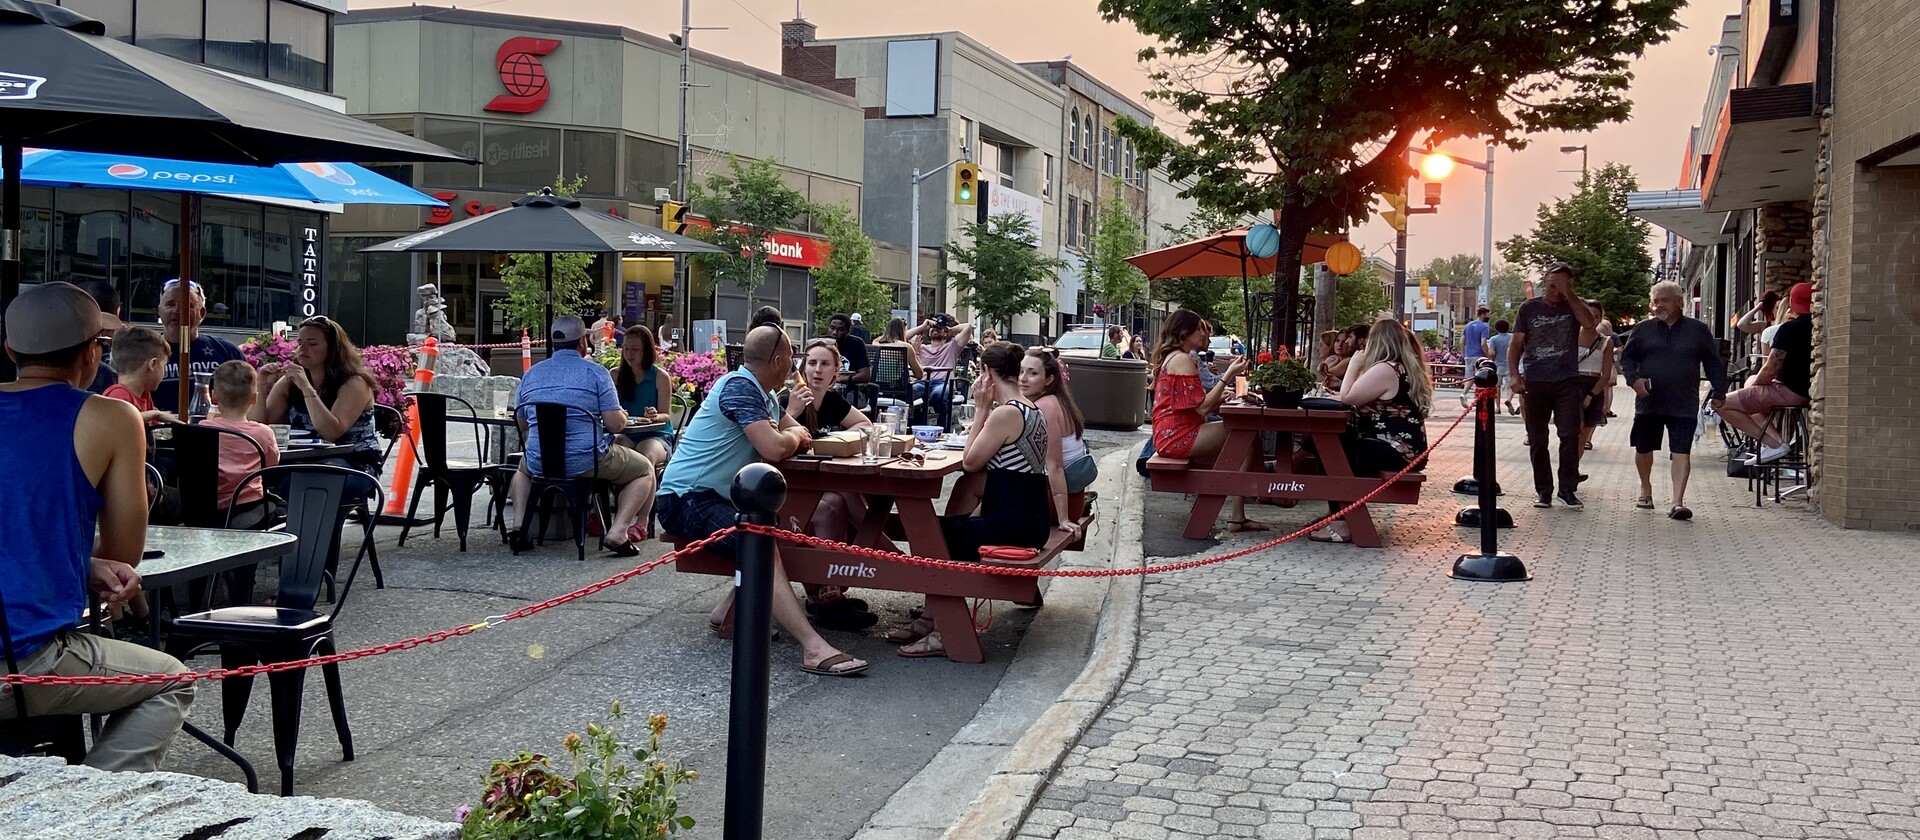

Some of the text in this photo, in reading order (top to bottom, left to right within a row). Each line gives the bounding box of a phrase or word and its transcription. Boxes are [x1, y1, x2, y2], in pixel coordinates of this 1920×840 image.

[152, 171, 234, 184] pepsi
[303, 227, 317, 317] TATTOO
[577, 307, 595, 317] 225
[1268, 480, 1305, 493] parks
[827, 562, 877, 579] parks
